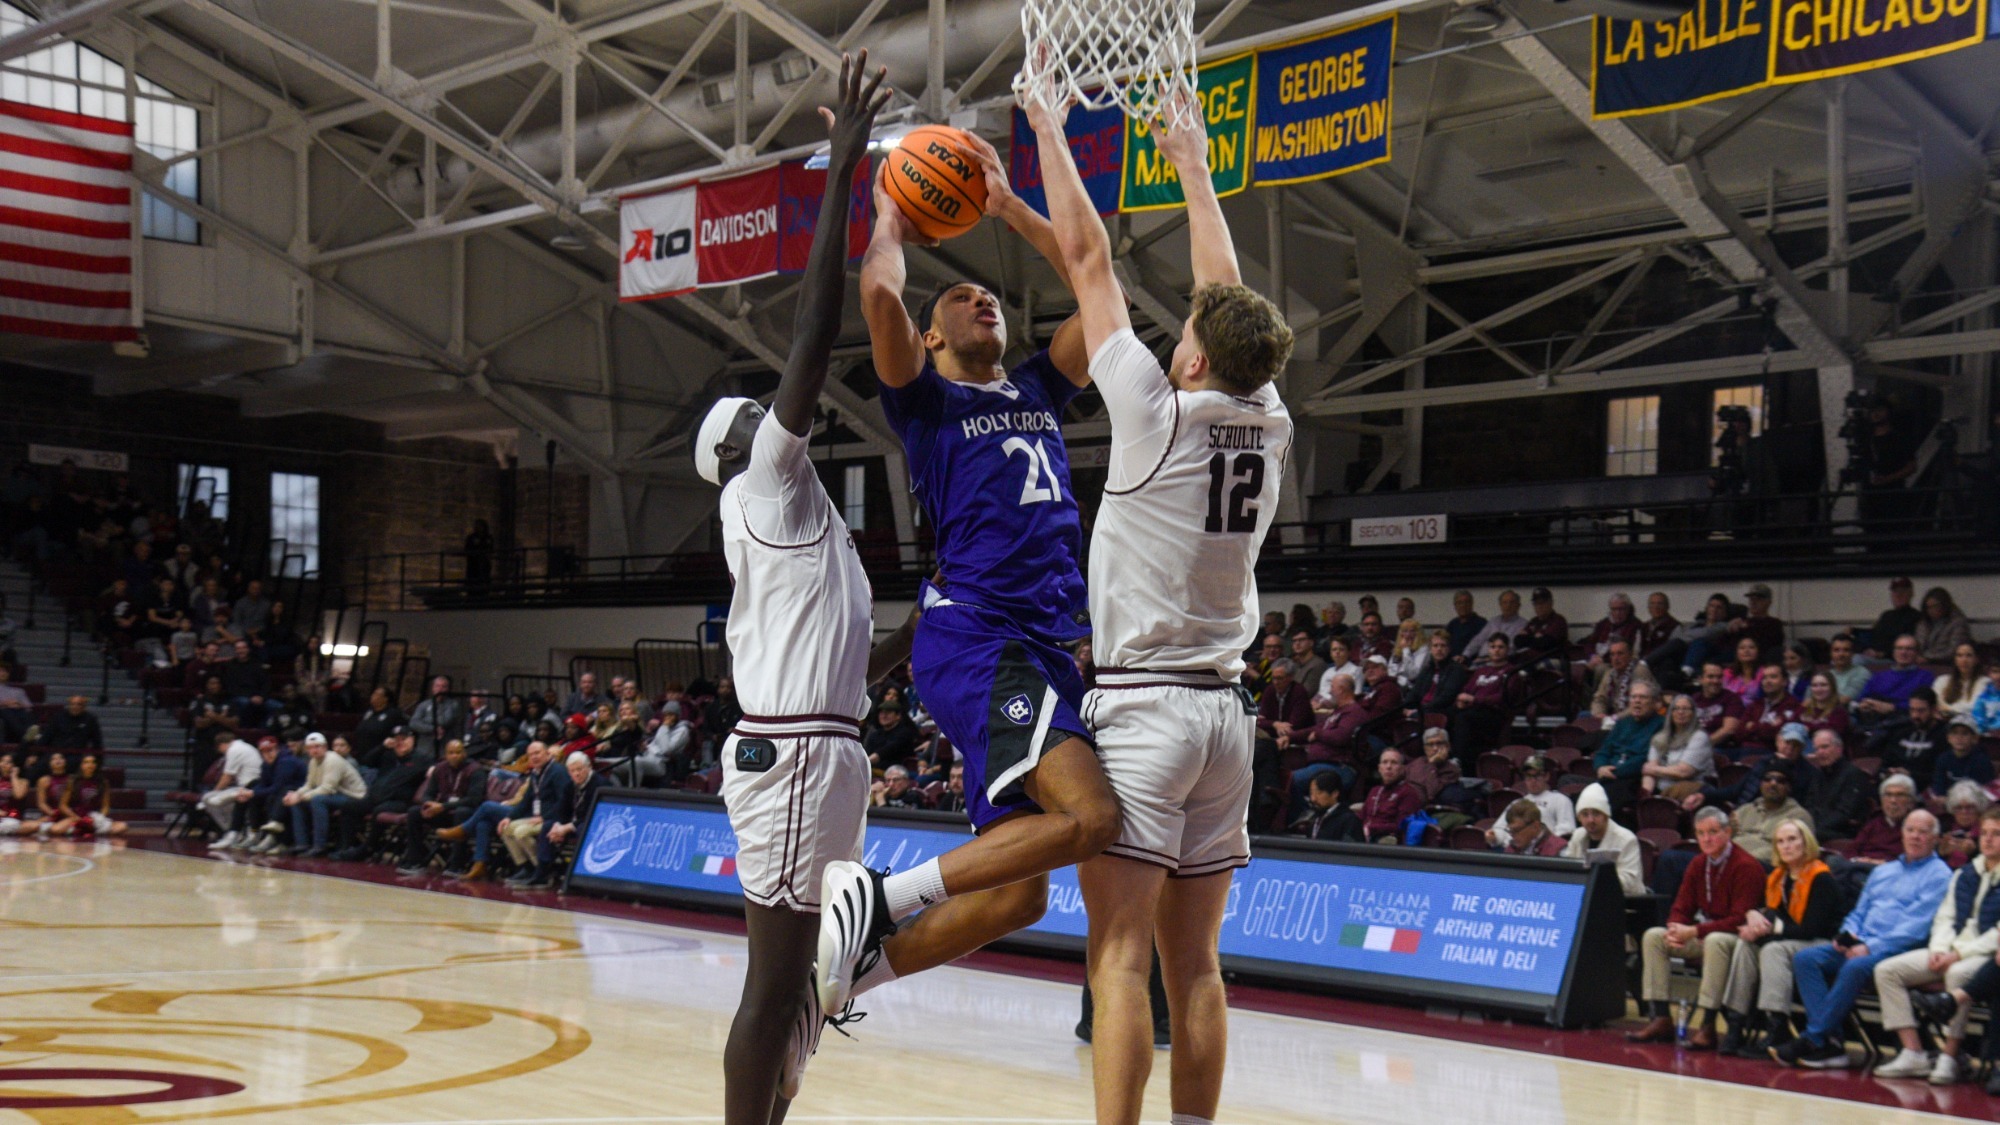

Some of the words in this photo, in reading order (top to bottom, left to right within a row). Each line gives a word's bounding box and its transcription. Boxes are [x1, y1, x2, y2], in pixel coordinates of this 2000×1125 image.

[1604, 15, 1645, 66] LA
[1654, 0, 1762, 58] SALLE
[1279, 47, 1369, 106] GEORGE
[1256, 99, 1388, 163] WASHINGTON
[926, 141, 975, 182] NCAA
[1017, 124, 1121, 190] DUESNE
[1135, 131, 1239, 186] MAN
[901, 159, 962, 219] Wilson
[624, 228, 692, 264] A10
[700, 204, 777, 247] DAVIDSON
[962, 411, 1012, 439] HOLY
[1013, 411, 1059, 432] CROSS
[1208, 425, 1264, 450] SCHULTE
[1001, 436, 1062, 506] 21
[1205, 452, 1265, 533] 12
[1359, 524, 1403, 538] SECTION
[1408, 518, 1438, 540] 103
[1047, 884, 1087, 914] TALIA
[1242, 877, 1340, 944] GRECO'S
[1347, 903, 1429, 928] TRADIZIONE
[1350, 887, 1431, 910] ITALIANA
[1452, 894, 1481, 913] THE
[1485, 897, 1557, 921] ORIGINAL
[1434, 918, 1494, 940] ARTHUR
[1497, 927, 1561, 948] AVENUE
[1441, 943, 1498, 966] ITALIAN
[1503, 951, 1538, 971] DELI
